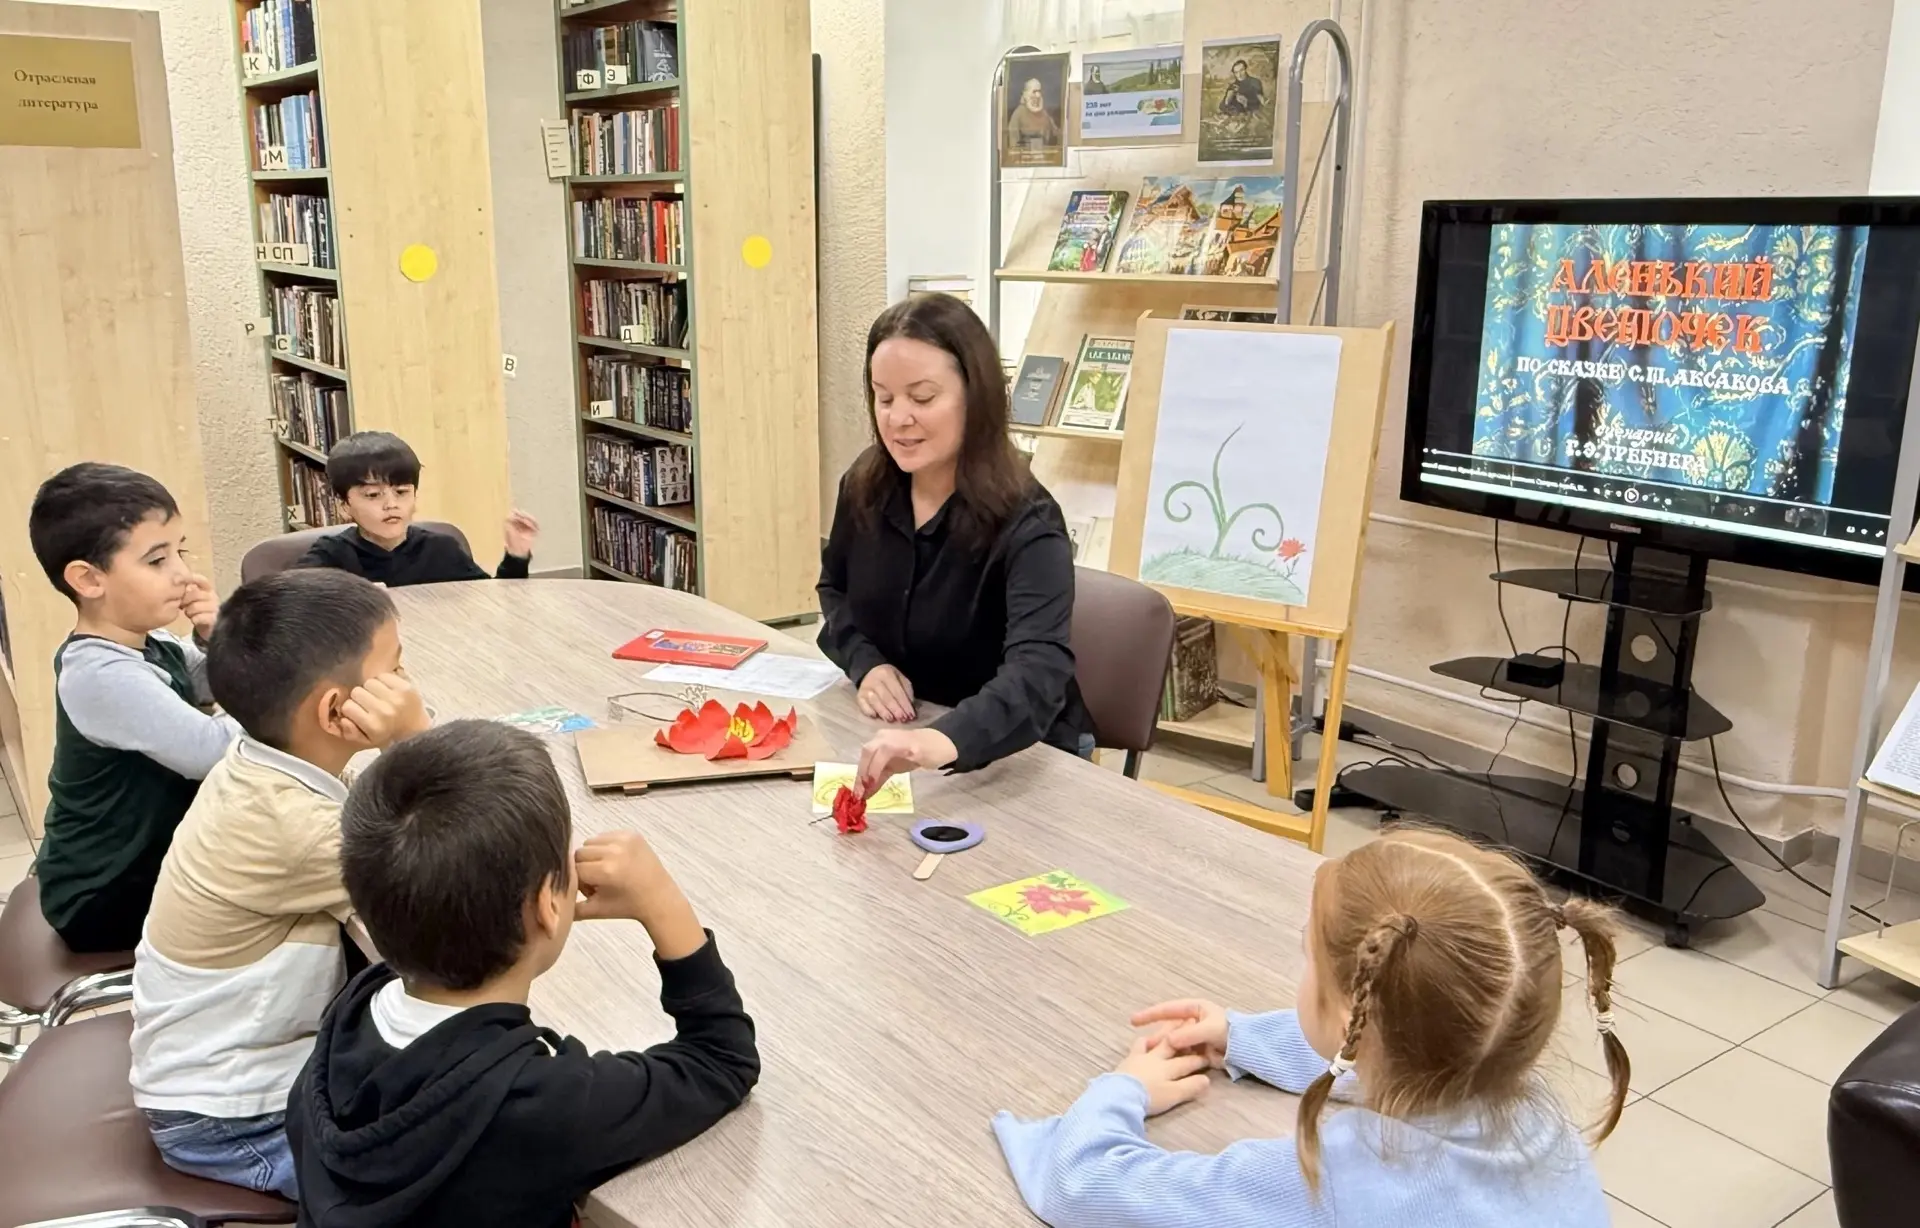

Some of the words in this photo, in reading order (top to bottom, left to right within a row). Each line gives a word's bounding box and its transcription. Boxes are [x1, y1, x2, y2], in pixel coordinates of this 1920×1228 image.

[582, 72, 595, 86] Ф
[606, 68, 616, 82] Э
[18, 98, 99, 113] литература
[1550, 255, 1774, 301] АЛЕНЬКИЙ
[244, 322, 255, 336] Р
[1544, 304, 1770, 353] ЦВЕТОЧЕК
[277, 338, 288, 351] С
[504, 357, 515, 372] В
[1516, 356, 1541, 373] ПО
[1547, 358, 1623, 380] СКАЗКЕ
[592, 404, 601, 416] И
